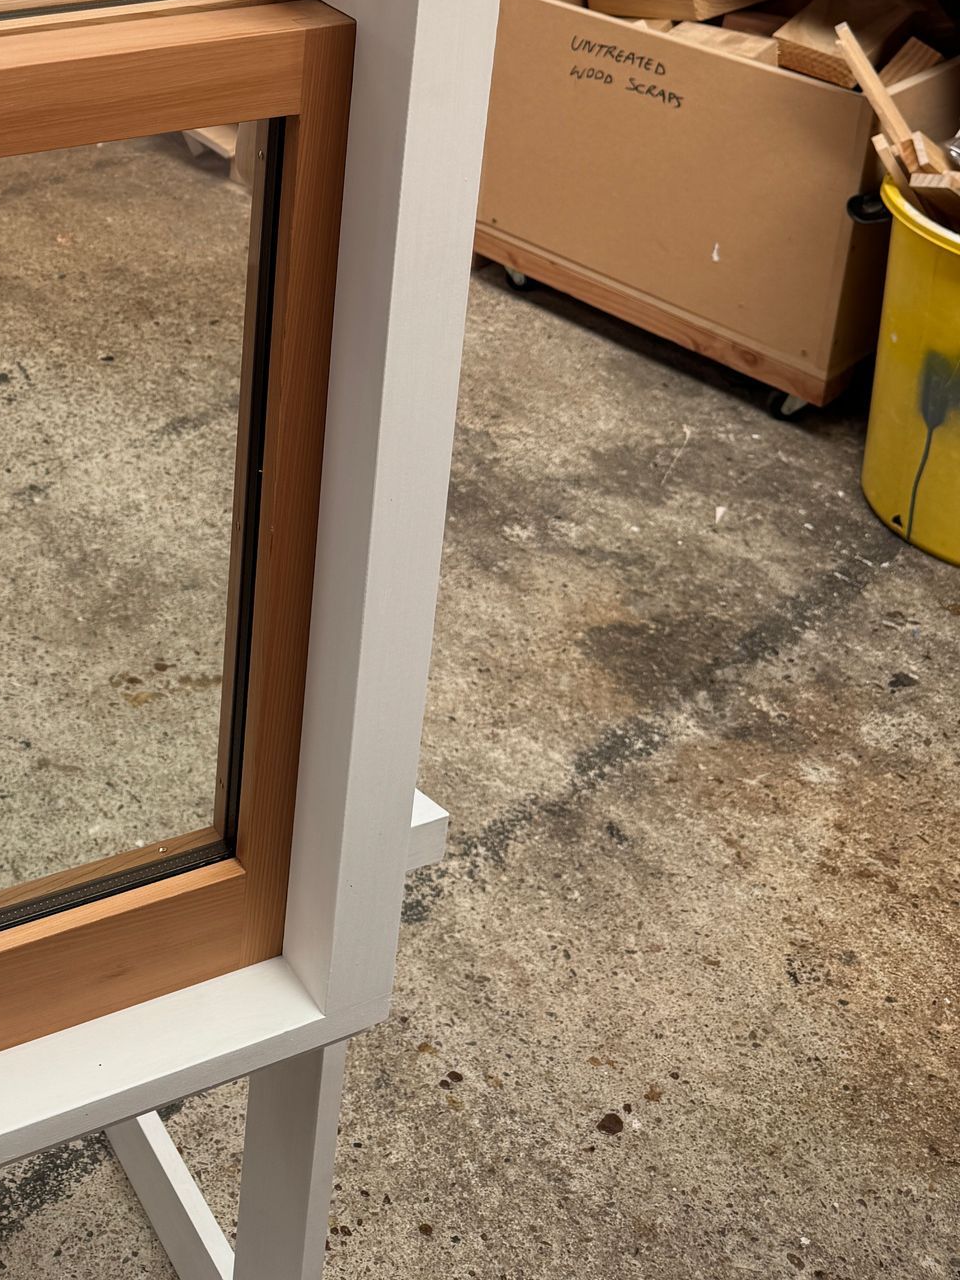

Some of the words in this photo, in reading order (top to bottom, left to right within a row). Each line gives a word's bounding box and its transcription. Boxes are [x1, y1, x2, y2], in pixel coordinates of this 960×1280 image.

[570, 35, 666, 76] UNTREATED
[570, 65, 613, 85] WOOD
[625, 77, 684, 108] SCRAPS
